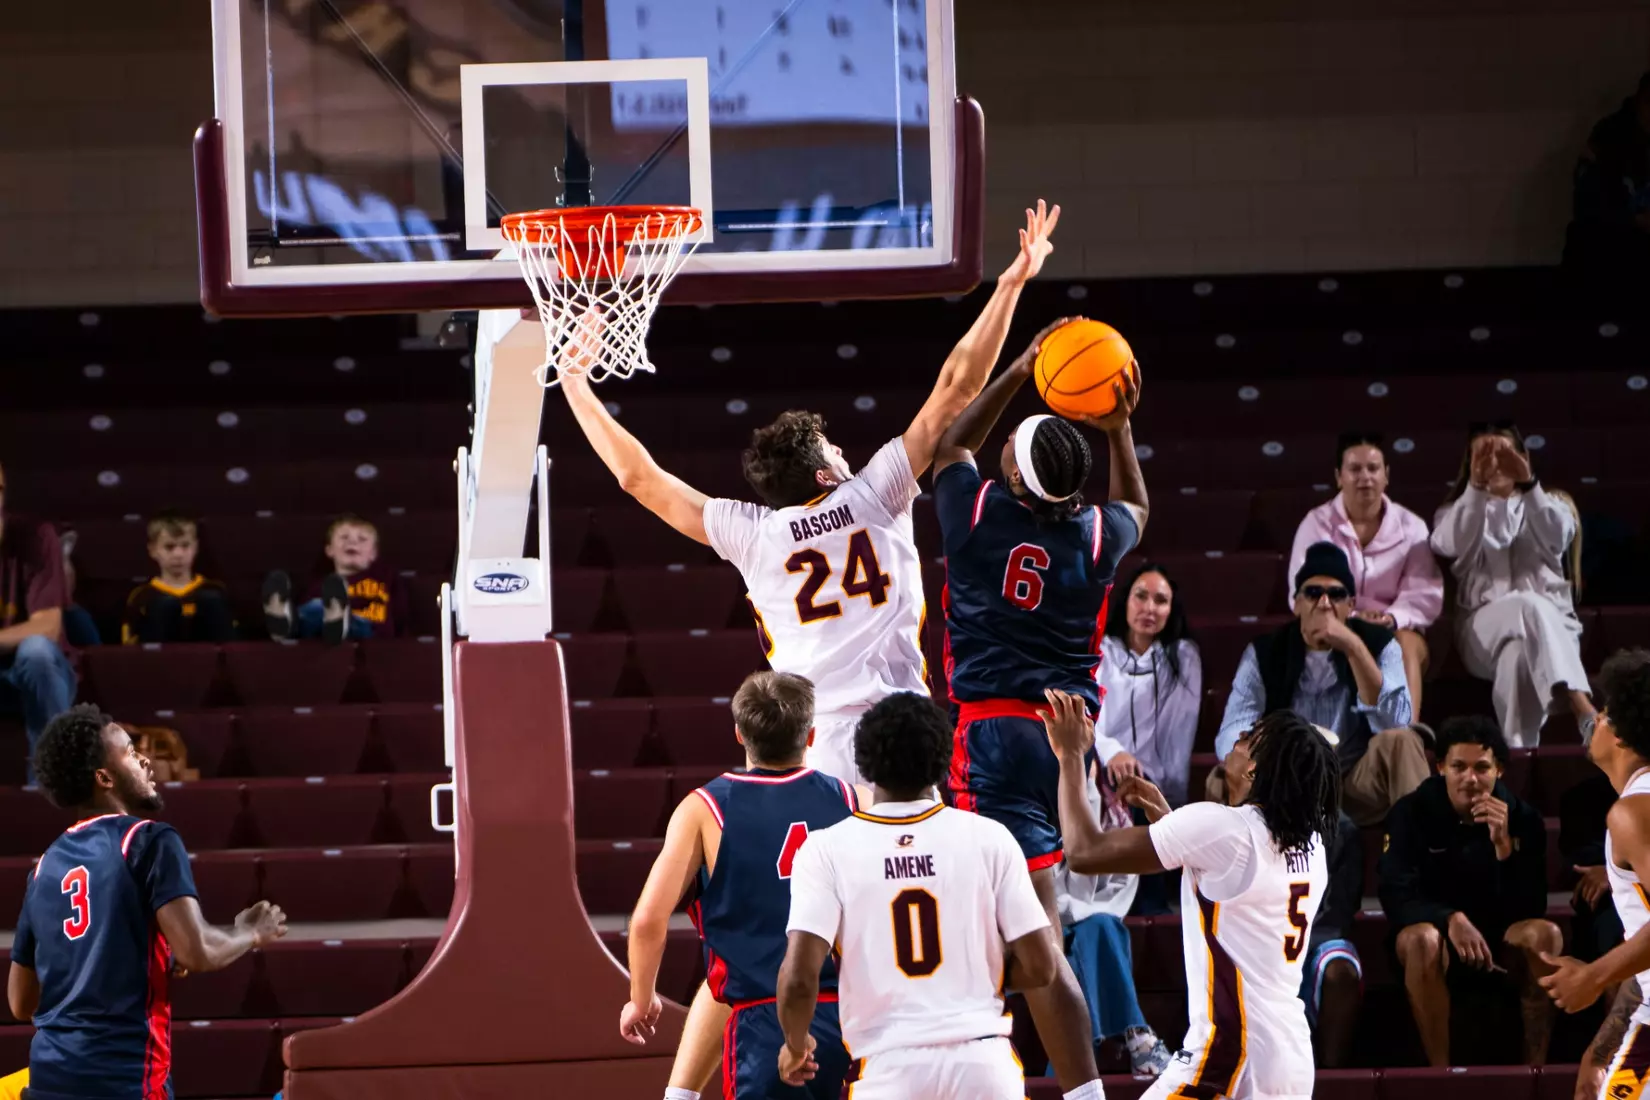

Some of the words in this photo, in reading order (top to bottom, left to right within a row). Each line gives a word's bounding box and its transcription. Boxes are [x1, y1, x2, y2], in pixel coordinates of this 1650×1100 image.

[789, 504, 855, 542] BASCOM
[784, 527, 891, 625] 24
[1002, 542, 1051, 611] 6
[885, 854, 936, 879] AMENE
[1285, 851, 1310, 873] PETTY
[61, 865, 91, 941] 3
[891, 888, 942, 978] 0
[1284, 881, 1310, 963] 5
